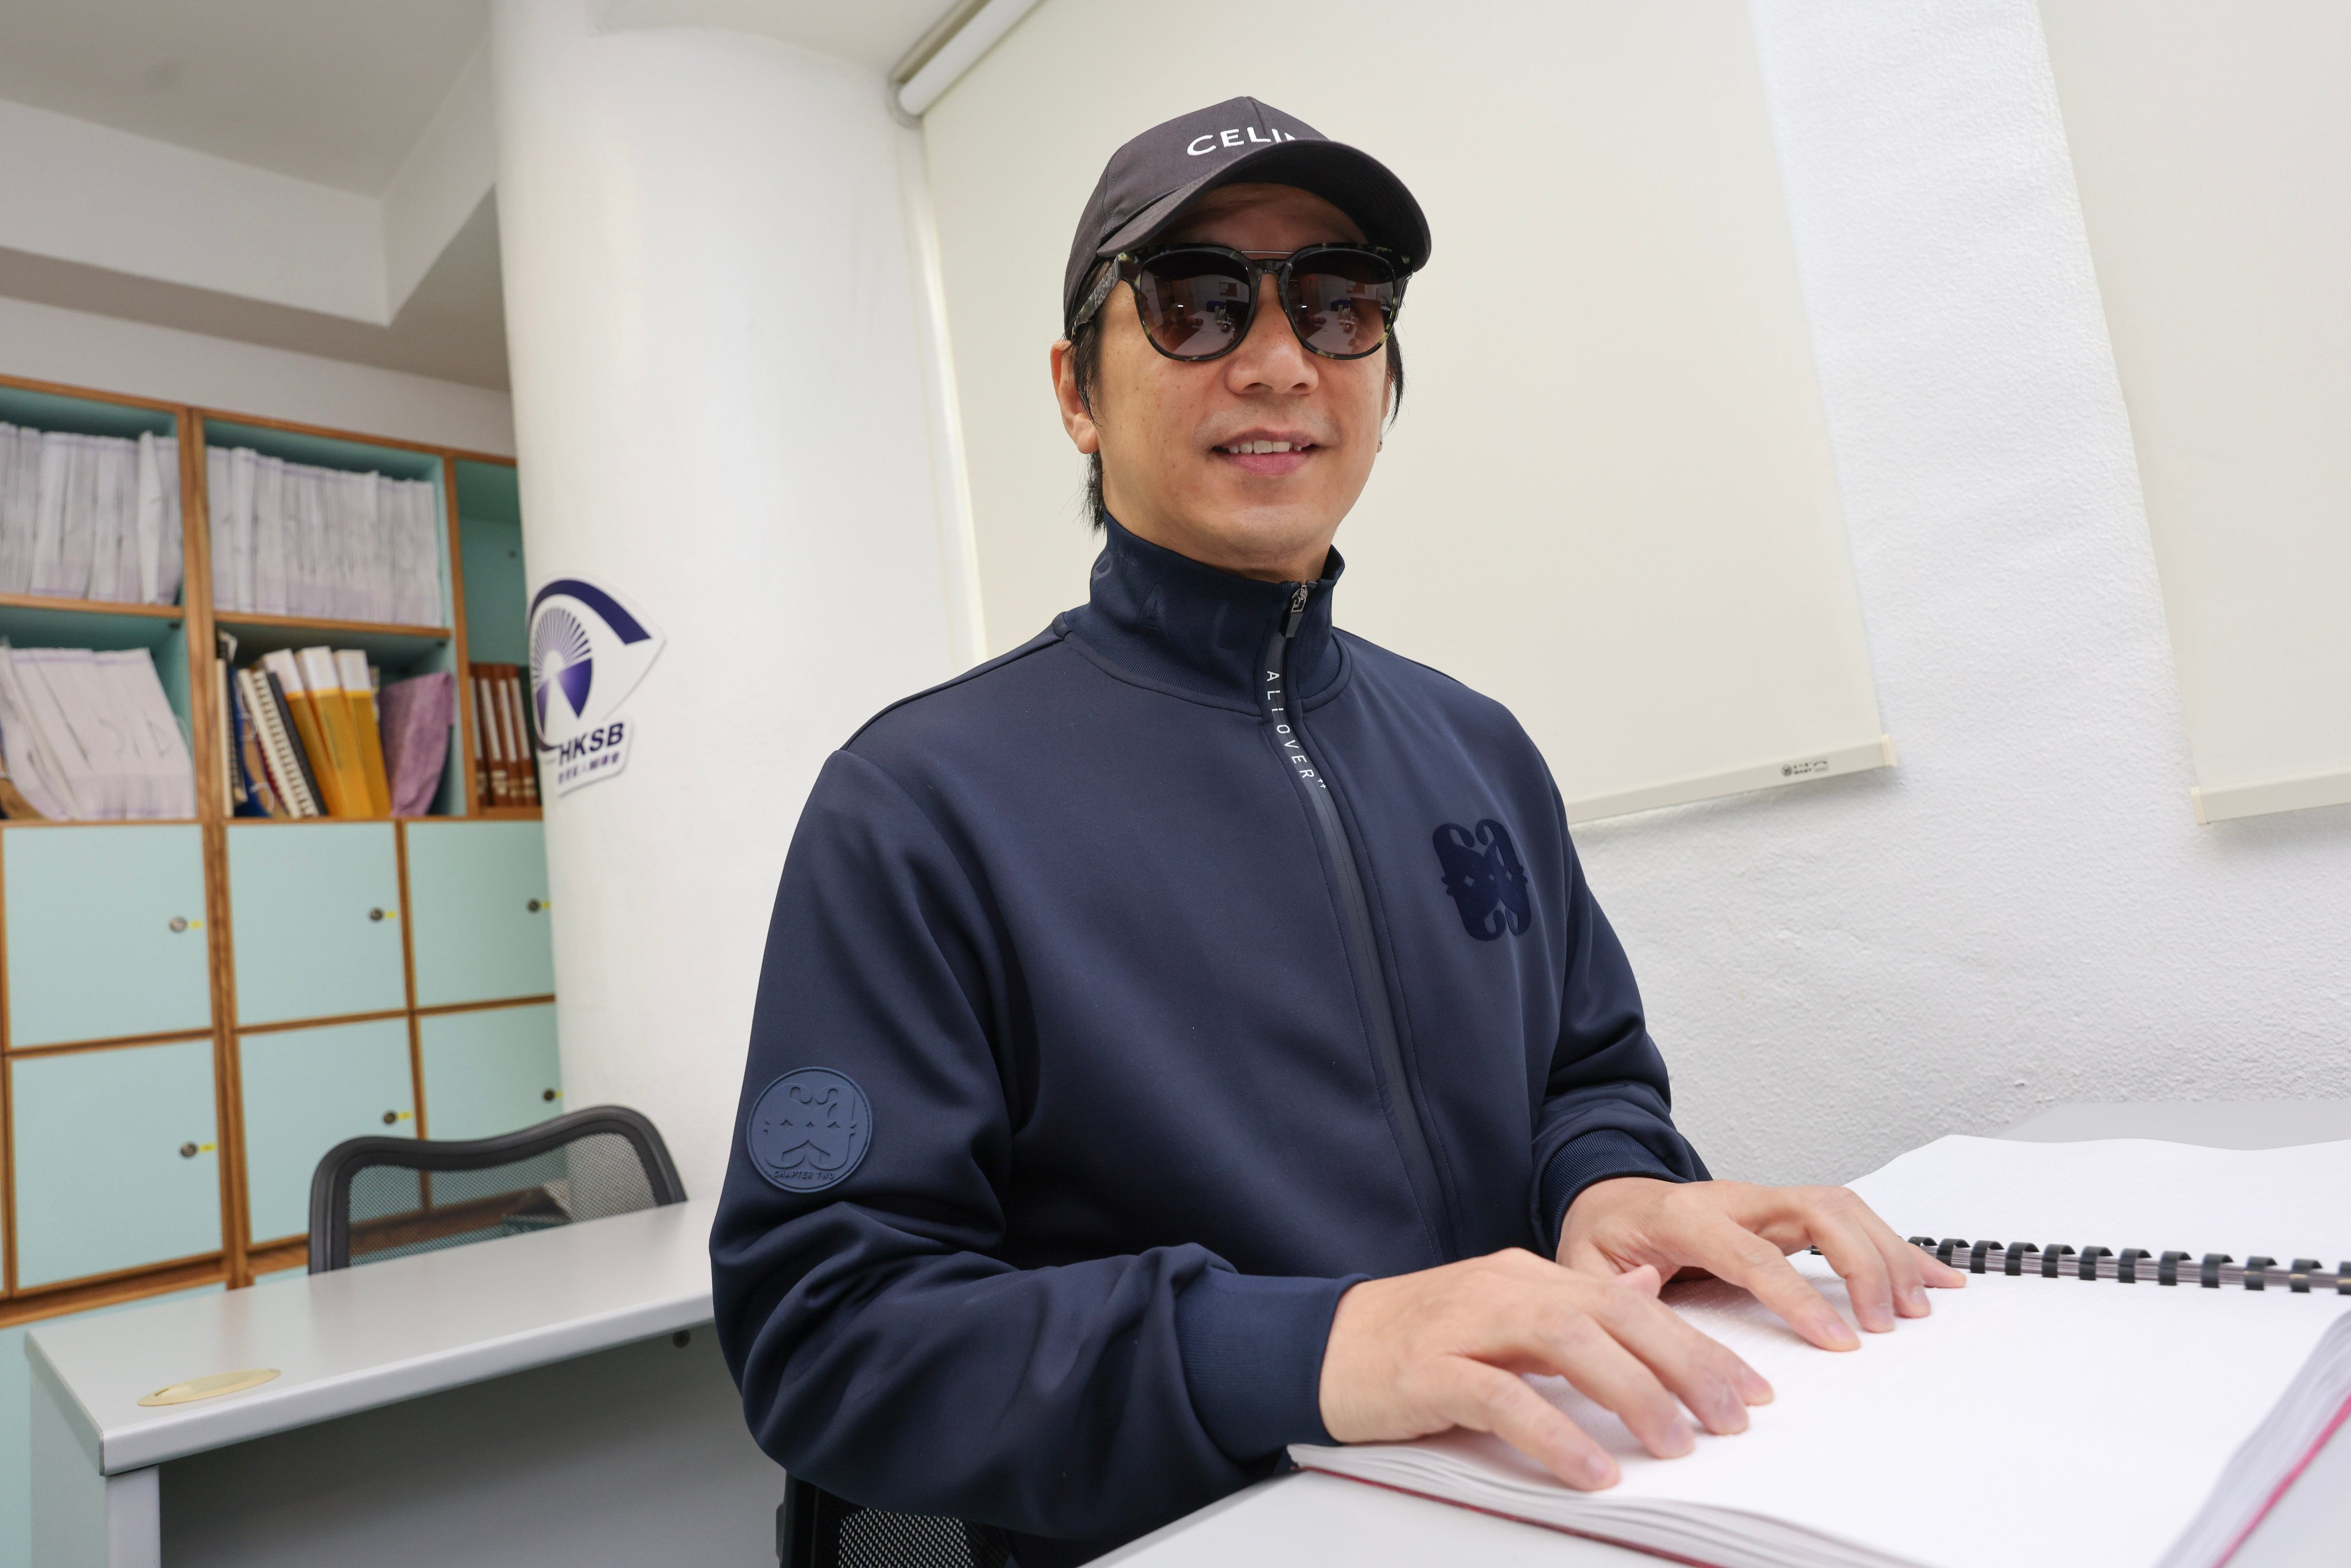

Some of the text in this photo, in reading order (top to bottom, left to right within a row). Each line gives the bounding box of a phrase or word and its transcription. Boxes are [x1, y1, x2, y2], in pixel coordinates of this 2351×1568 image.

[1187, 126, 1295, 156] CELI
[558, 723, 624, 765] HKSB
[774, 1170, 835, 1180] CHAPTER TWO
